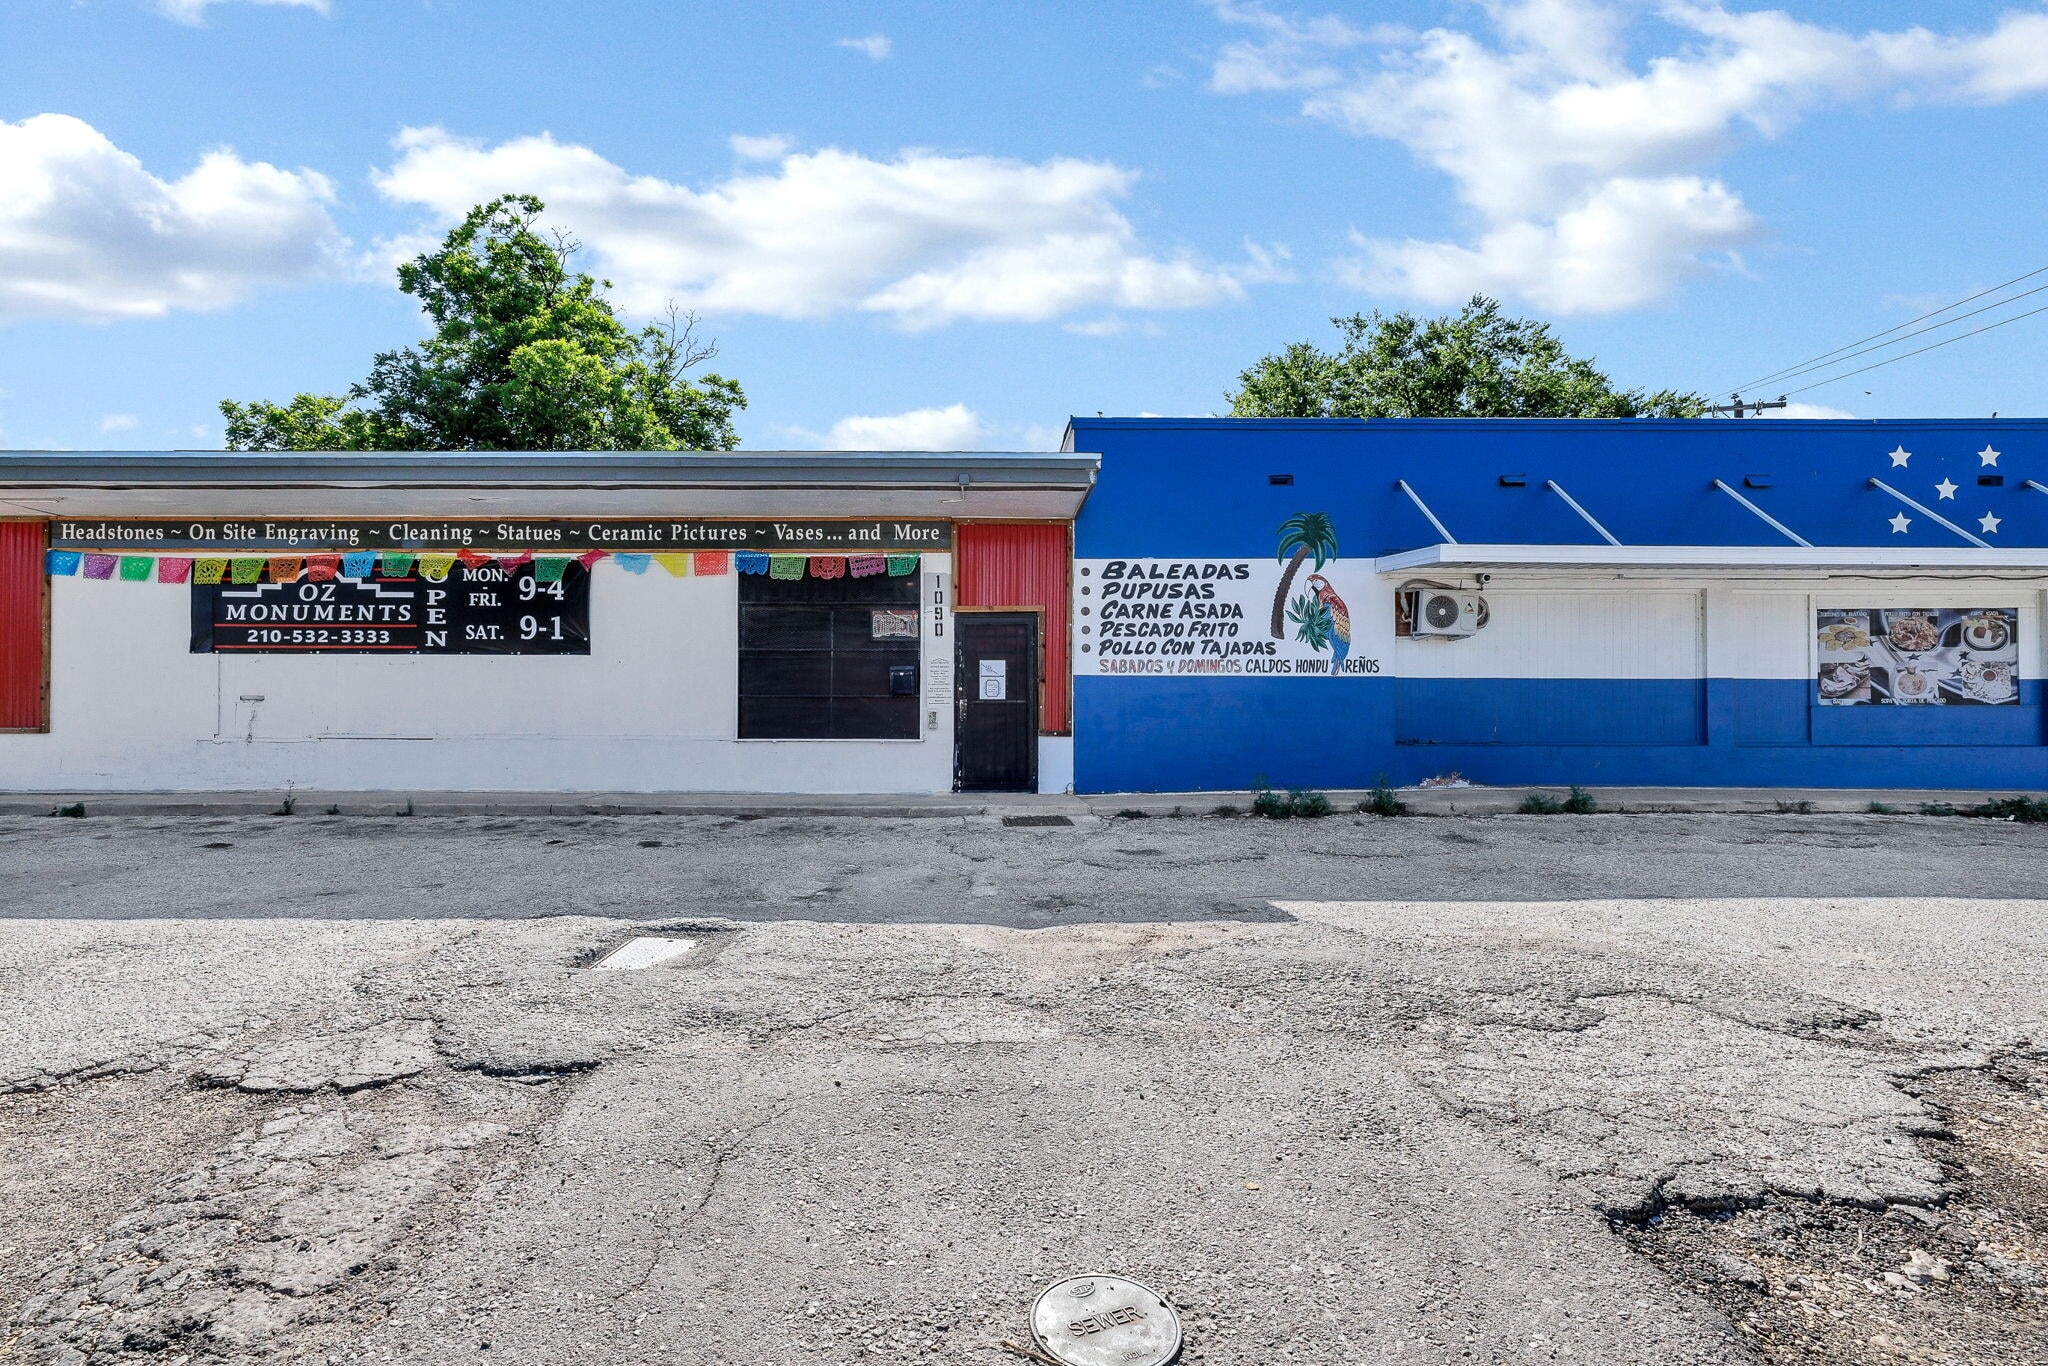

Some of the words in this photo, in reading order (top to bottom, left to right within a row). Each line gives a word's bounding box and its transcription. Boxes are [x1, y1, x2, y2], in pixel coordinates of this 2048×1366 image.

[61, 524, 164, 540] Headstones
[189, 524, 216, 540] On
[223, 524, 256, 540] Site
[265, 524, 360, 545] Engraving
[389, 524, 473, 545] Cleaning
[497, 524, 561, 540] Statues
[588, 524, 662, 540] Ceramic
[671, 524, 747, 540] Pictures
[848, 524, 881, 540] and
[893, 524, 940, 540] More
[462, 568, 509, 582] MON.
[1101, 561, 1250, 580] BALEADAS
[298, 583, 336, 602] OZ
[518, 576, 565, 601] 9-4
[1101, 582, 1216, 600] PUPUSAS
[469, 593, 502, 607] FRI.
[935, 575, 943, 636] 1090
[1100, 600, 1174, 619] CARNE
[1178, 601, 1244, 619] ASADA
[225, 604, 411, 621] MONUMENTS
[247, 629, 390, 644] 210-532-3333
[465, 624, 504, 640] SAT.
[519, 615, 564, 640] 9-1
[1100, 621, 1185, 637] PESCADO
[1187, 620, 1239, 637] FRITO
[1099, 639, 1157, 656] POLLO
[1161, 639, 1196, 655] CON
[1200, 639, 1277, 658] TAJADAS
[1100, 659, 1163, 673] SABADOS
[1178, 659, 1243, 674] DOMINGOS
[1245, 659, 1292, 673] CALDOS
[1068, 1306, 1144, 1336] SEWER
